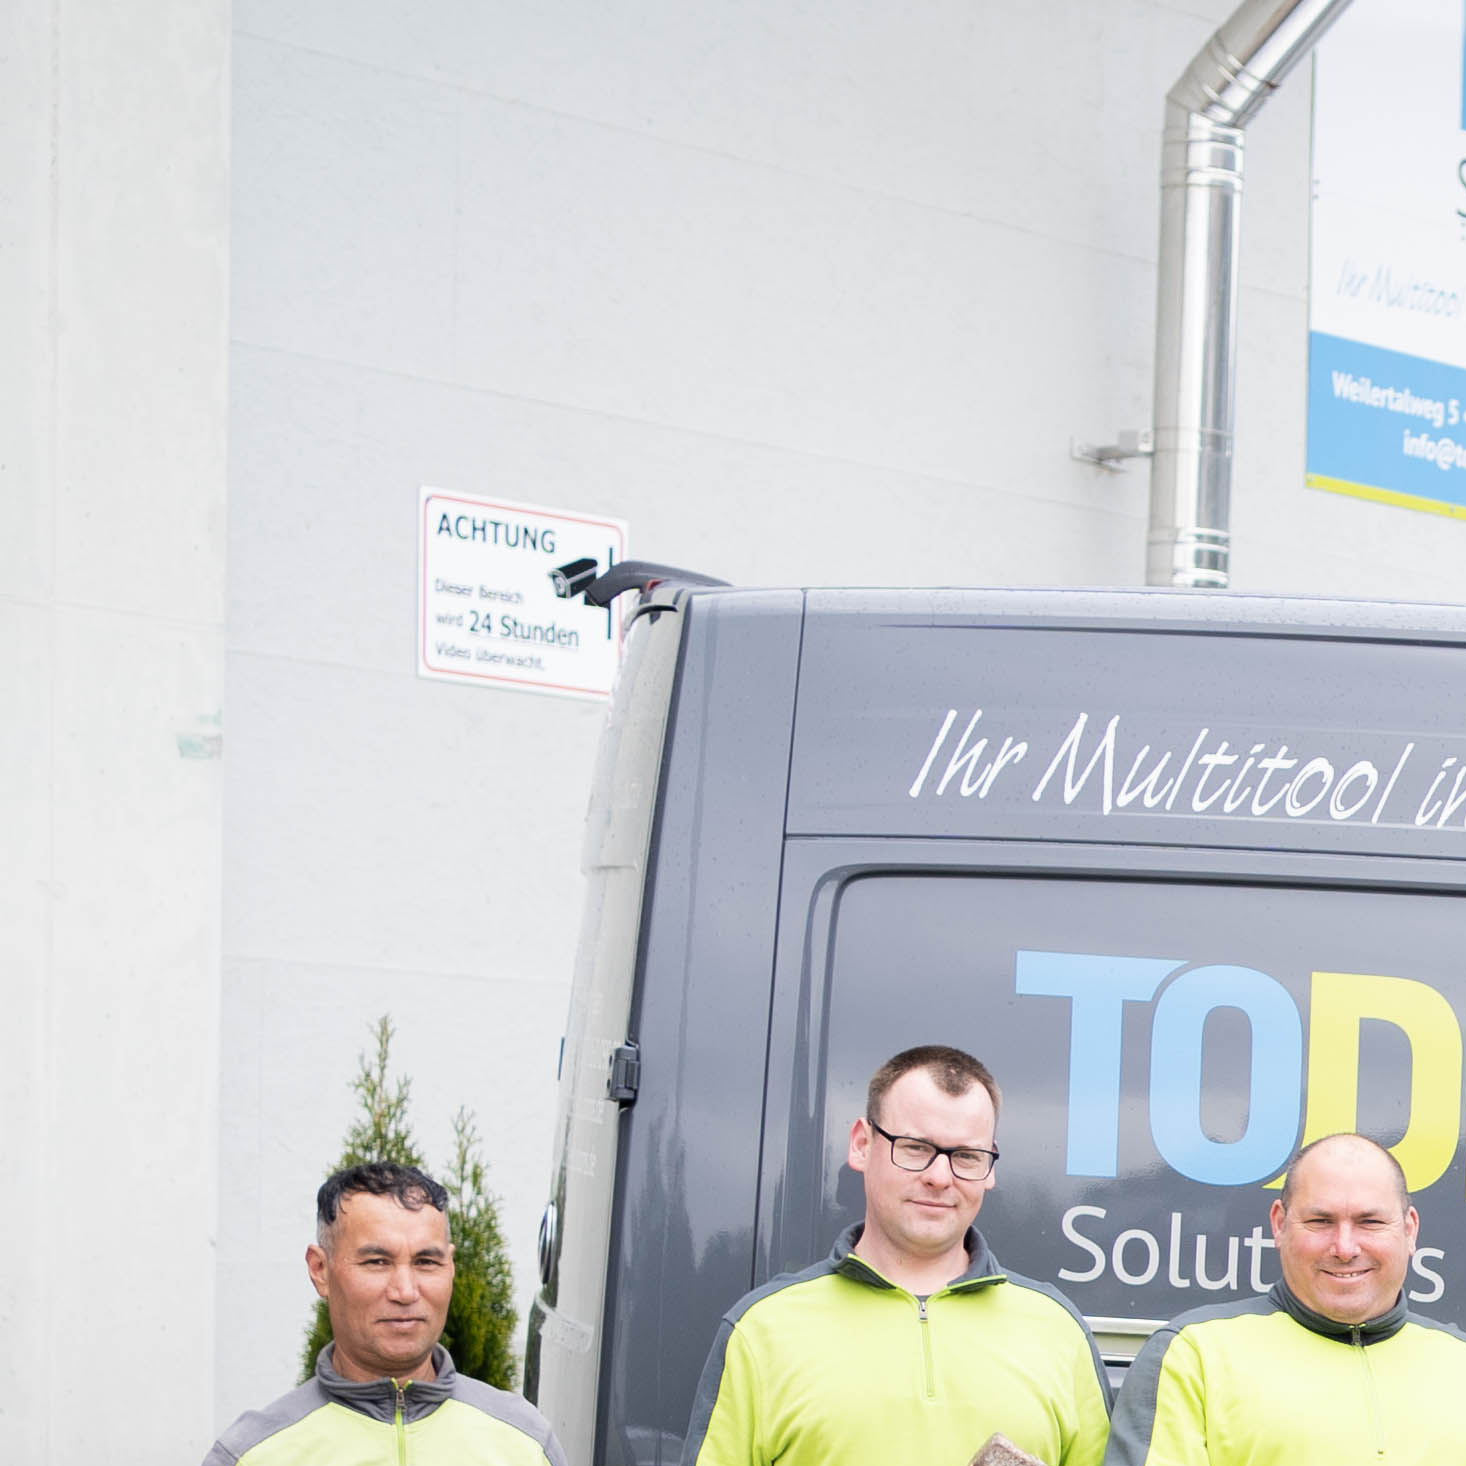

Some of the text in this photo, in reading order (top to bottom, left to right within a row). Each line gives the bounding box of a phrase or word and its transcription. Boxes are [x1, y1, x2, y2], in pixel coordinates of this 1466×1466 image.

[1447, 399, 1460, 426] 5
[437, 513, 556, 554] ACHTUNG
[469, 609, 492, 634] 24
[500, 615, 579, 648] Stunden
[909, 709, 1027, 799] Ihr
[1032, 711, 1411, 826] Multitool
[1059, 1206, 1446, 1303] Soluts
